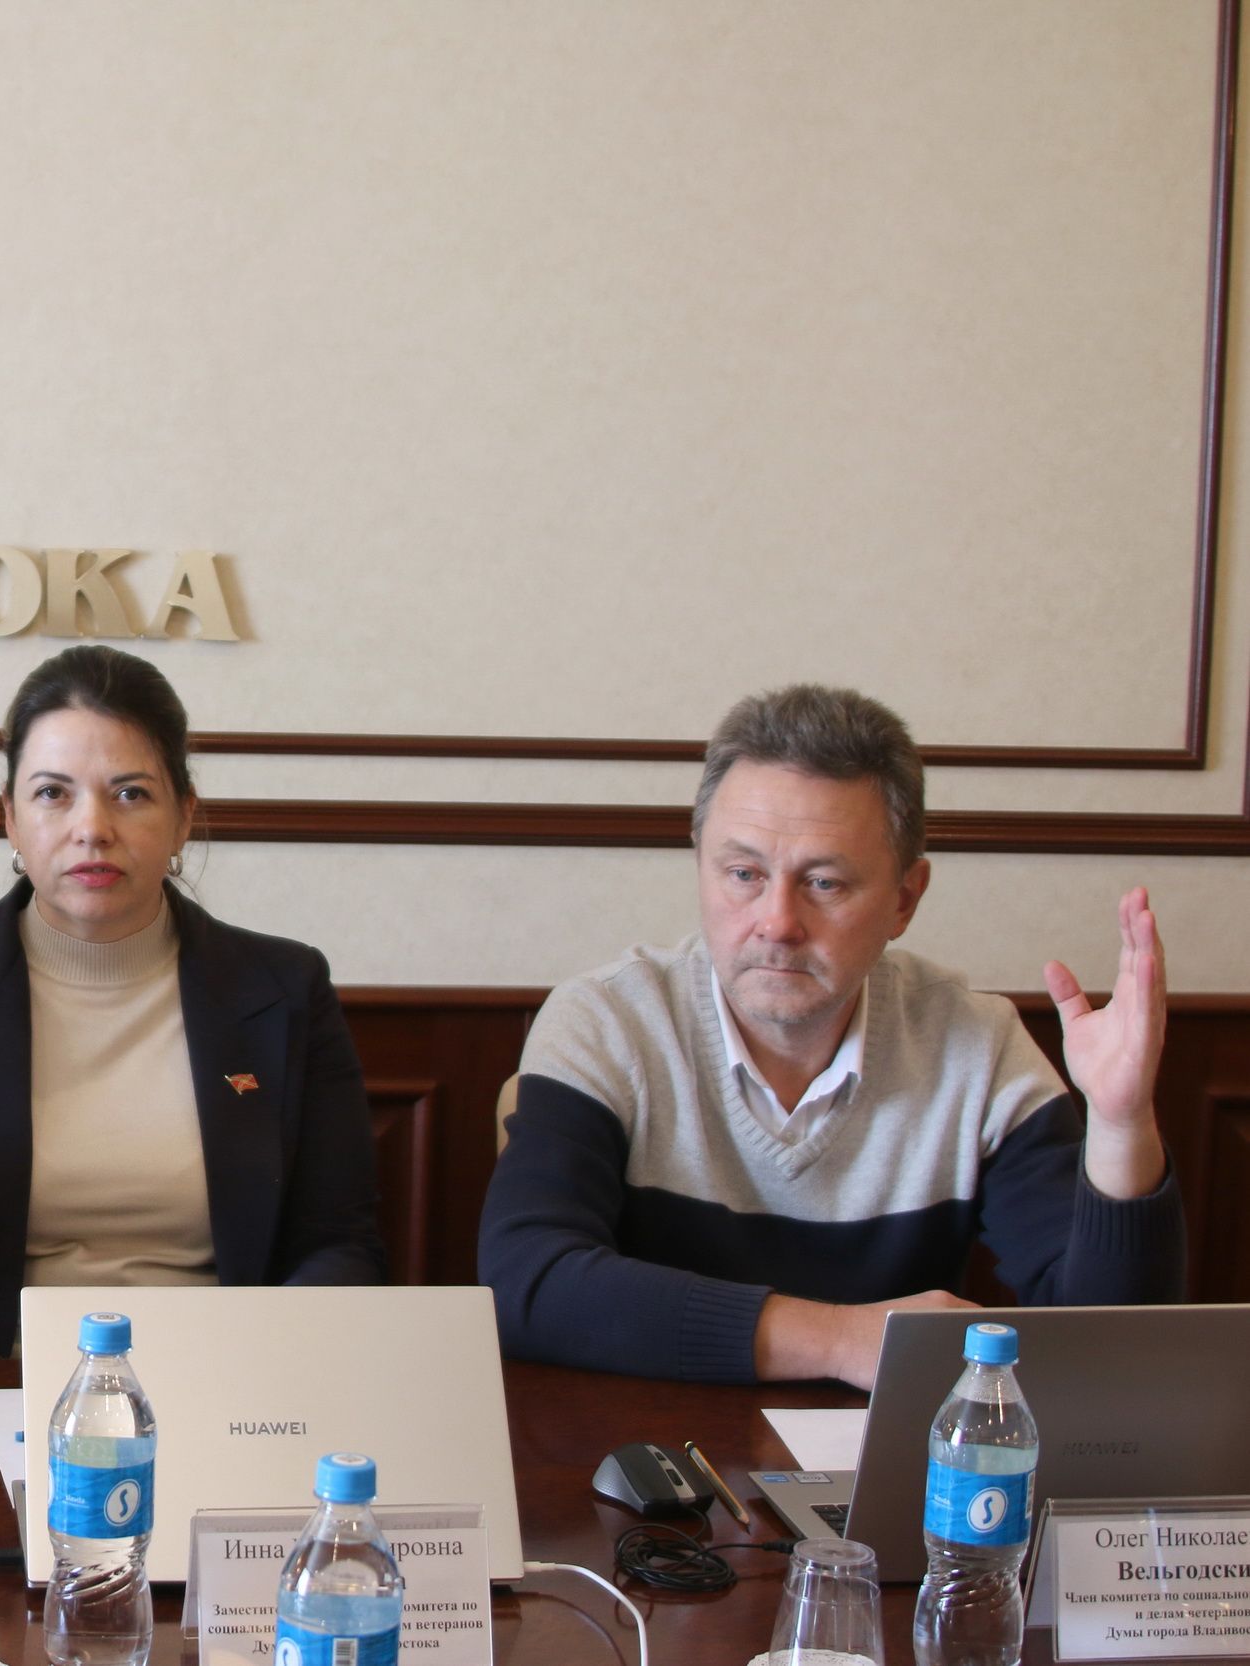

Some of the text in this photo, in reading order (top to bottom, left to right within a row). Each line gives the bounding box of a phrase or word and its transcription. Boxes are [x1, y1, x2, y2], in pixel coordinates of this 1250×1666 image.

[229, 1421, 307, 1435] HUAWEI
[1062, 1442, 1139, 1455] HUAWEI
[1095, 1526, 1250, 1549] Олег Николае
[224, 1539, 285, 1560] Инна
[1117, 1560, 1250, 1580] Вельгодски
[1065, 1590, 1250, 1603] Член комитета по социально
[462, 1601, 478, 1611] по
[1135, 1608, 1250, 1620] и делам ветеранов
[415, 1619, 483, 1632] ветеранов
[1105, 1624, 1250, 1641] Думы города Владивос
